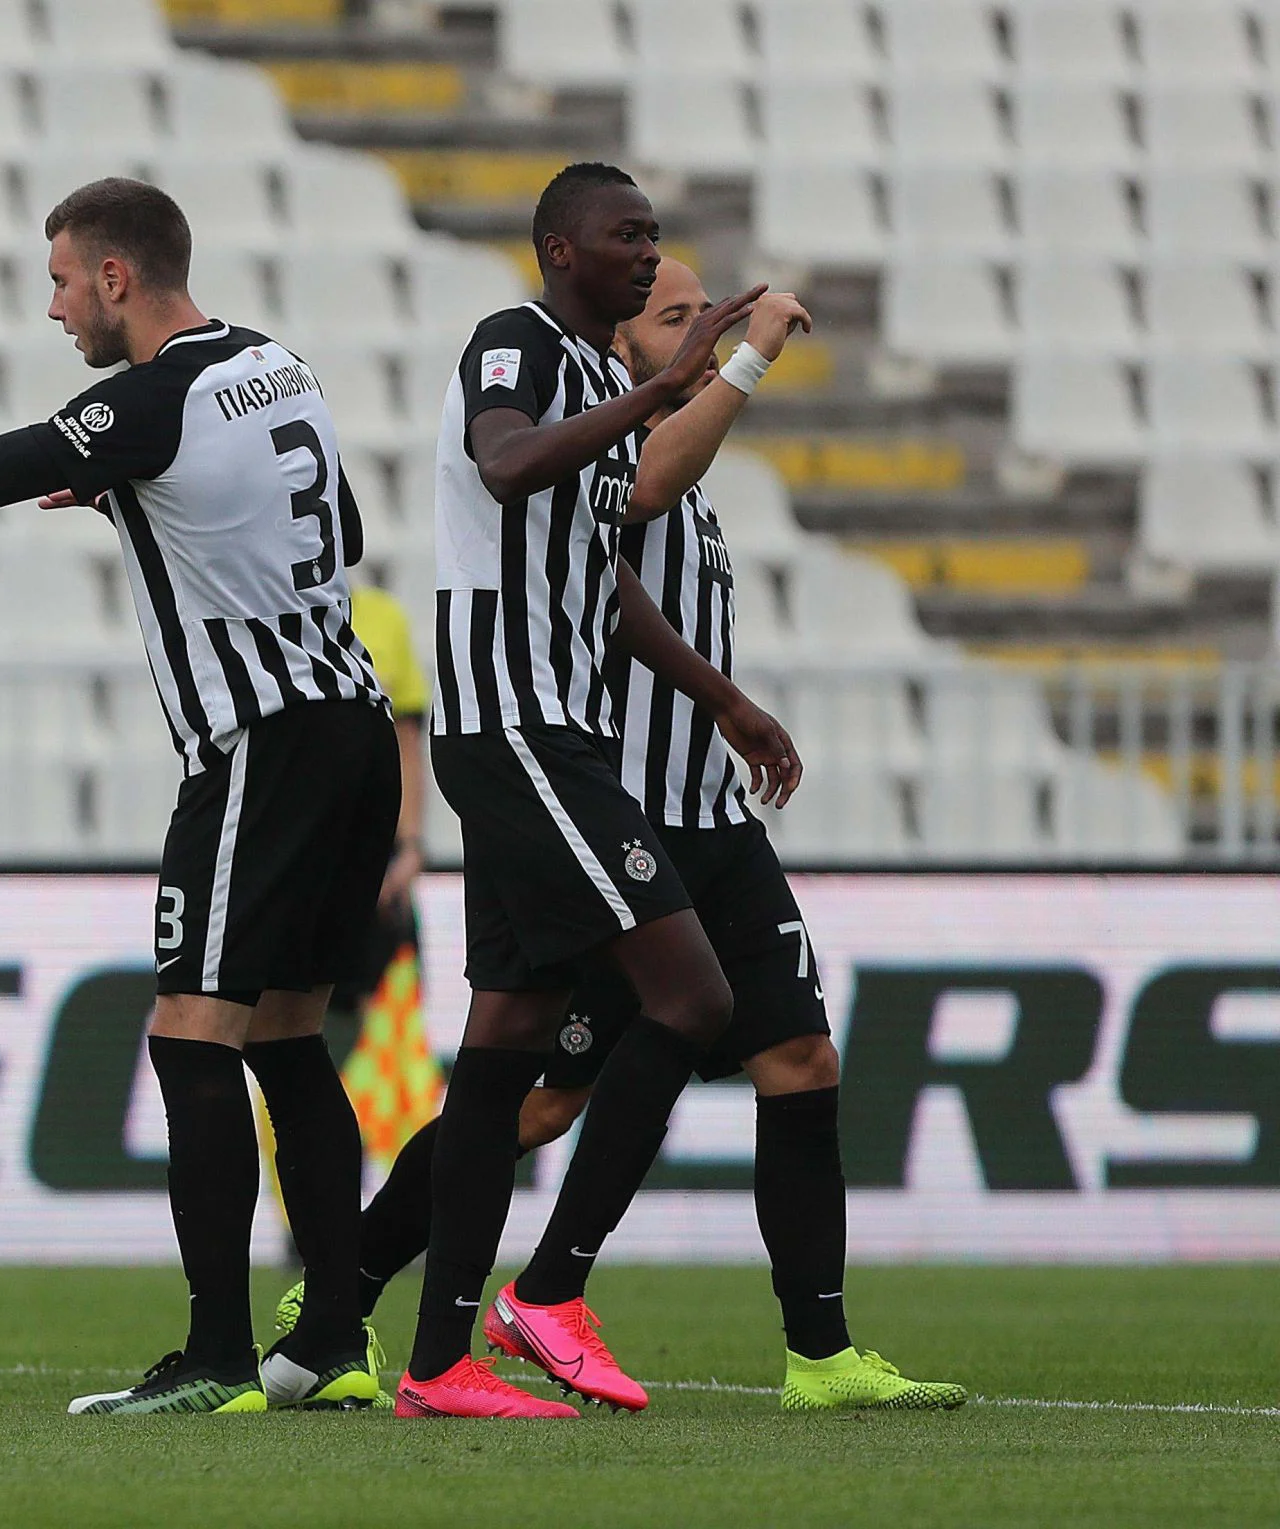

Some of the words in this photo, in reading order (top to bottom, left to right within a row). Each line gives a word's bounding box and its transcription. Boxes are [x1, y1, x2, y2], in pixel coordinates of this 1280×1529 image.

[269, 419, 337, 592] 3
[701, 534, 732, 576] mt
[158, 885, 185, 950] 3
[777, 920, 808, 978] 7
